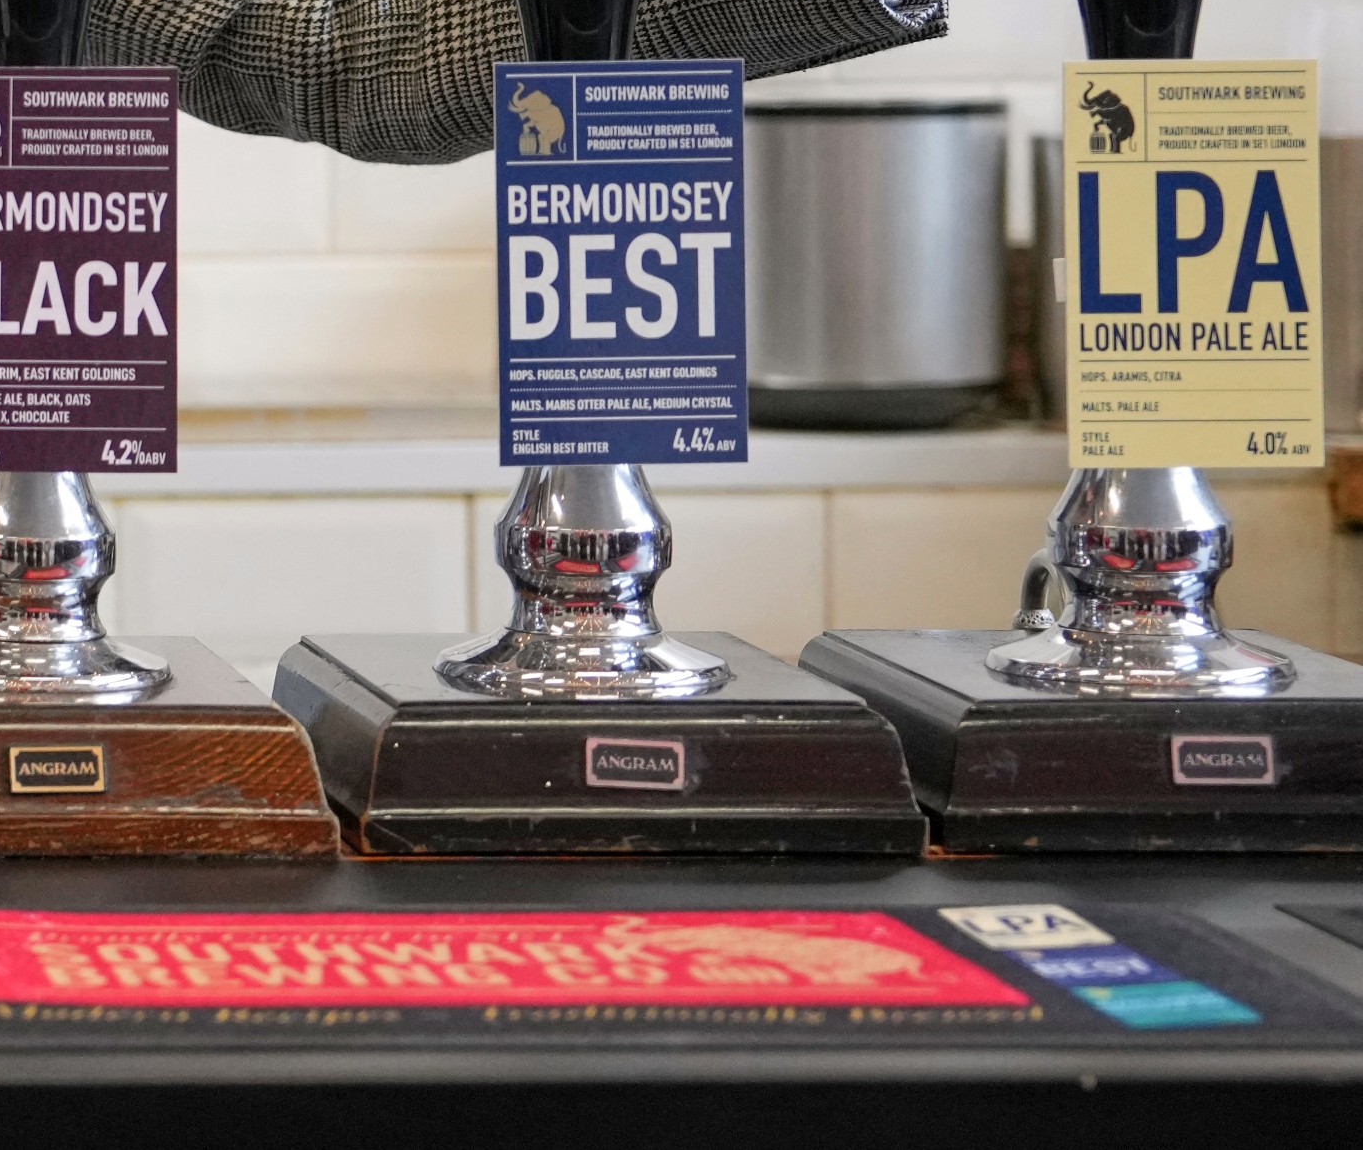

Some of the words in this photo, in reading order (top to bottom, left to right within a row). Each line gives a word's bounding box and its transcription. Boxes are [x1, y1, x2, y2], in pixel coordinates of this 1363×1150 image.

[23, 91, 106, 108] SOUTHWARK
[108, 91, 169, 109] BREWING
[584, 85, 666, 102] SOUTHWARK
[669, 84, 730, 101] BREWING
[1158, 86, 1241, 101] SOUTHWARK
[1244, 85, 1307, 100] BREWING
[22, 128, 89, 141] TRADITIONALLY
[90, 129, 128, 141] BREWED
[129, 129, 155, 143] BEER,
[587, 124, 653, 137] TRADITIONALLY
[654, 124, 692, 136] BREWED
[693, 123, 719, 136] BEER,
[21, 143, 62, 156] PROUDLY
[63, 144, 102, 156] CRAFTED
[103, 144, 114, 156] IN
[115, 144, 131, 156] SE1
[133, 144, 169, 157] LONDON
[587, 138, 626, 151] PROUDLY
[627, 137, 667, 150] CRAFTED
[668, 137, 678, 149] IN
[679, 137, 696, 149] SE1
[697, 136, 733, 148] LONDON
[507, 181, 733, 225] BERMONDSEY
[1078, 169, 1309, 314] LPA
[508, 232, 732, 340] BEST
[1080, 322, 1182, 352] LONDON
[1191, 321, 1253, 351] PALE
[1261, 320, 1309, 351] ALE
[23, 366, 51, 381] EAST
[52, 367, 80, 381] KENT
[82, 367, 136, 382] GOLDINGS
[509, 369, 536, 381] HOPS.
[537, 368, 578, 382] FUGGLES,
[579, 368, 624, 381] CASCADE,
[625, 367, 647, 379] EAST
[648, 367, 672, 379] KENT
[673, 366, 718, 378] GOLDINGS
[1153, 371, 1183, 382] CITRA
[3, 393, 25, 408] ALE,
[27, 393, 64, 408] BLACK,
[65, 393, 91, 407] OATS
[511, 399, 544, 412] MALTS.
[545, 399, 576, 411] MARIS
[577, 398, 606, 411] OTTER
[607, 398, 630, 410] PALE
[631, 397, 652, 411] ALE,
[653, 396, 691, 409] MEDIUM
[691, 396, 733, 409] CRYSTAL
[1117, 401, 1140, 412] PALE
[1141, 401, 1160, 412] ALE
[0, 410, 10, 425] X,
[11, 410, 71, 424] CHOCOLATE
[512, 429, 540, 441] STYLE
[672, 426, 716, 453] 4.4%
[717, 439, 737, 452] ABV
[1081, 432, 1110, 443] STYLE
[1245, 430, 1289, 456] 4.0%
[512, 443, 552, 456] ENGLISH
[553, 442, 577, 455] BEST
[577, 441, 609, 454] BITTER
[1082, 445, 1105, 456] PALE
[1107, 445, 1125, 456] ALE
[595, 754, 675, 773] ANGRAM
[1183, 752, 1265, 767] ANGRAM
[18, 760, 96, 776] ANGRAM
[960, 912, 1087, 934] LPA
[31, 940, 670, 966] SOUTHWARK
[44, 963, 512, 987] BREWING
[542, 963, 669, 987] CO
